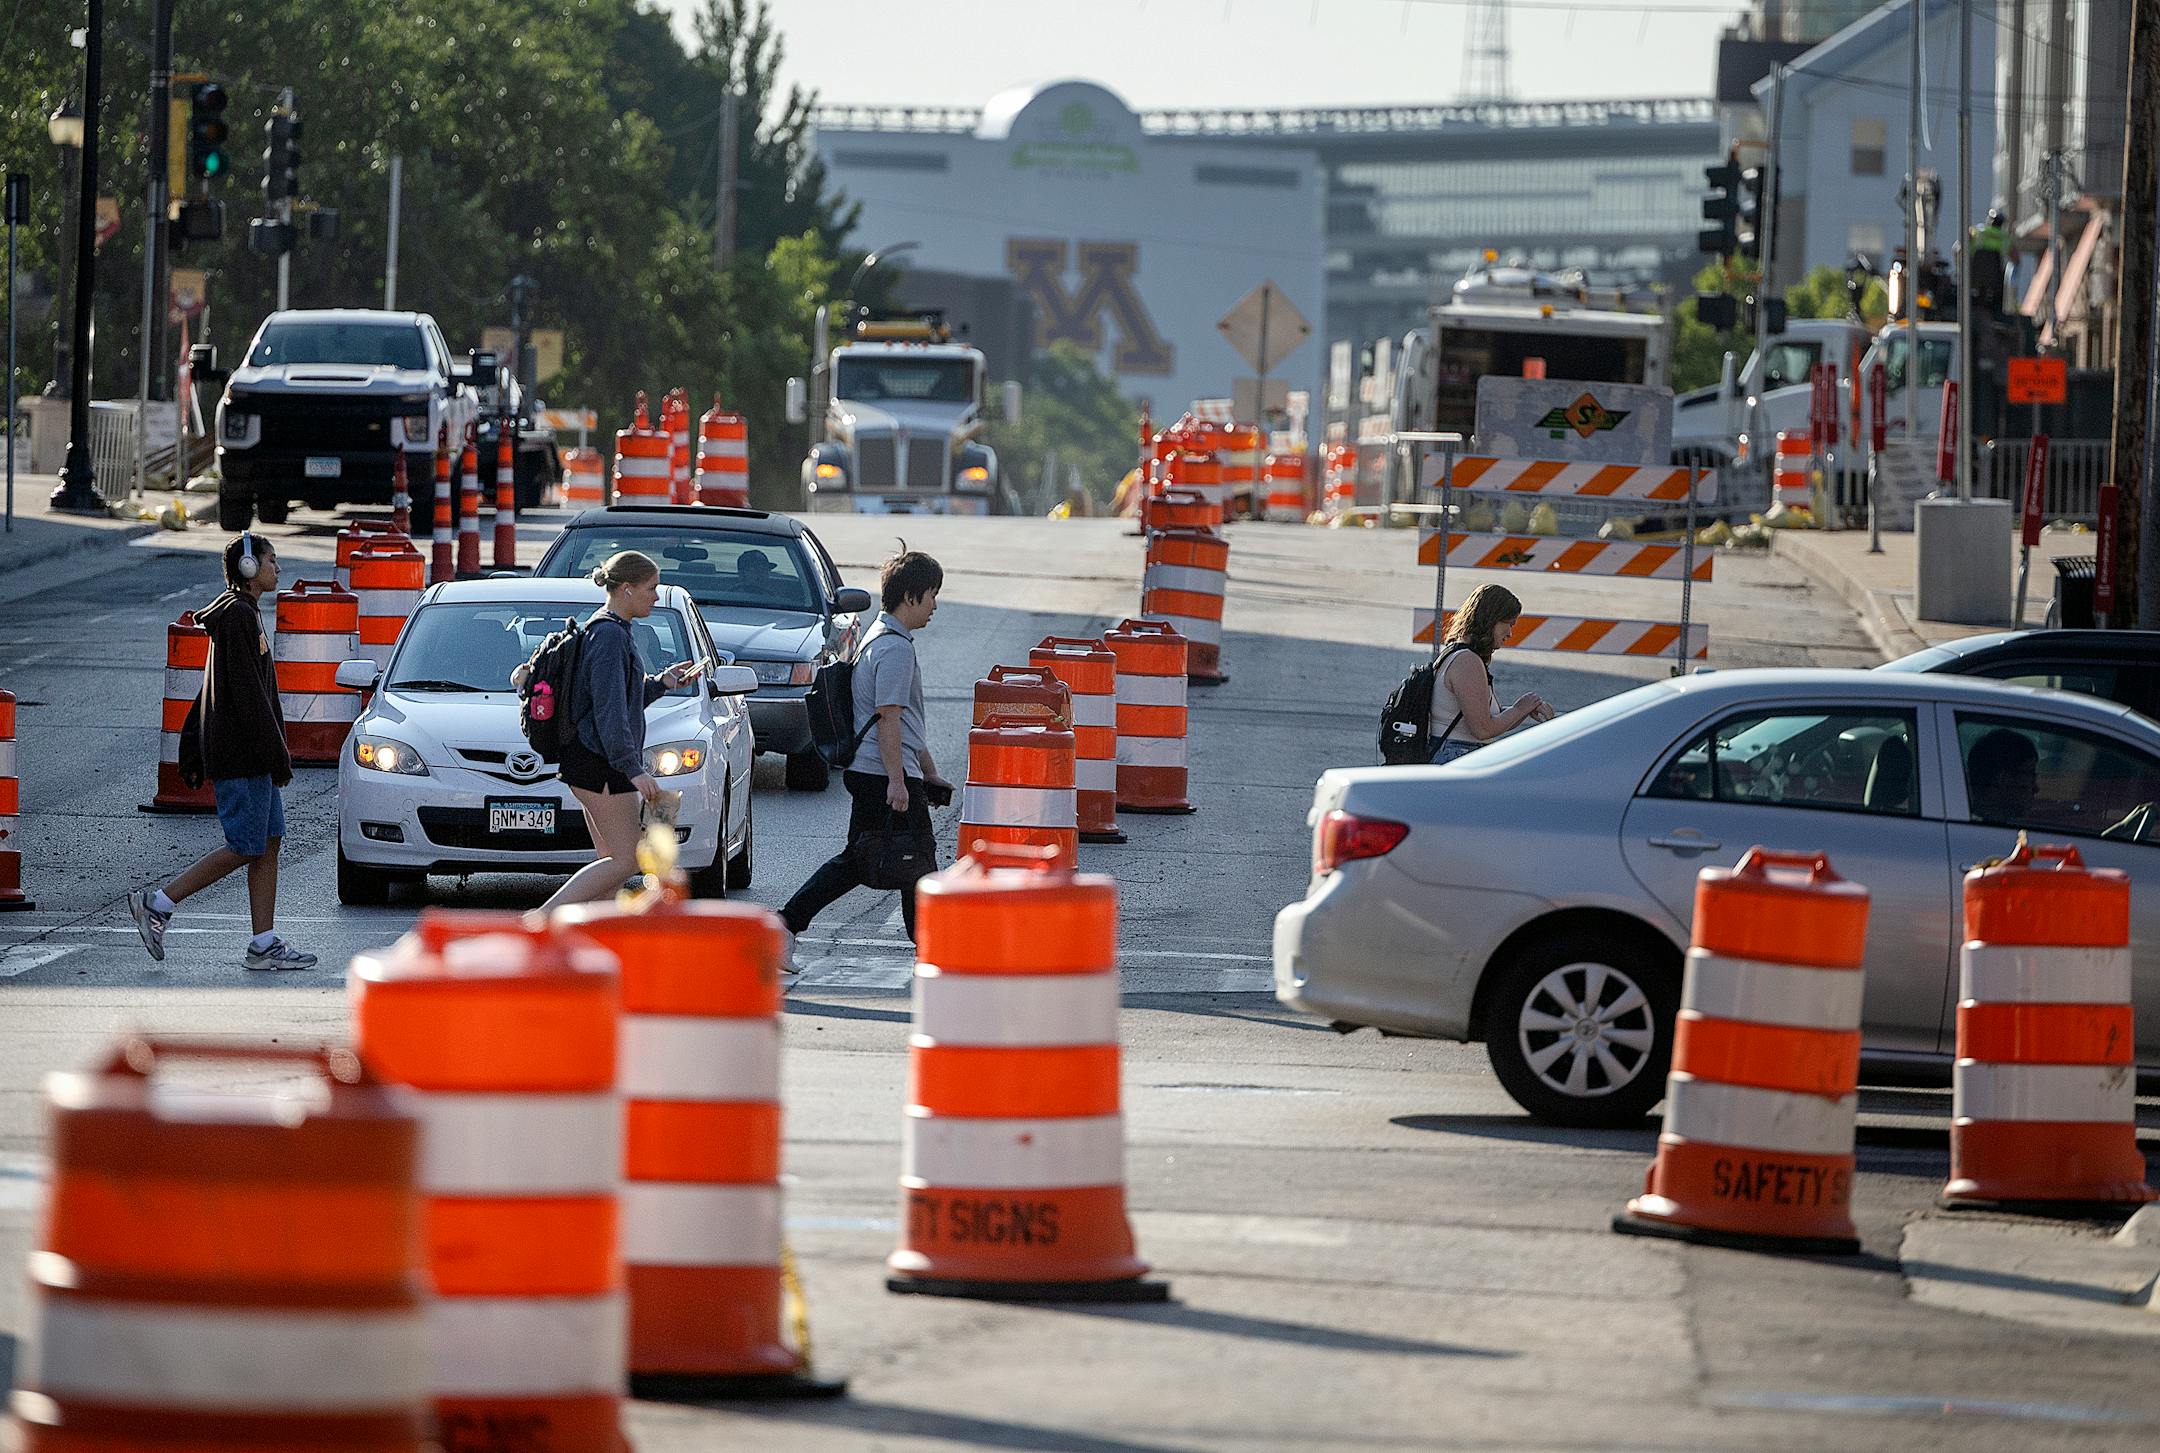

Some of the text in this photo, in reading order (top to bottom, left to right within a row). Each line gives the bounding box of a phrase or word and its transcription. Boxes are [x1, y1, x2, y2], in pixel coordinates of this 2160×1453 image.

[527, 811, 552, 828] 349
[1712, 1158, 1828, 1206] SAFETY
[949, 1198, 1058, 1245] SIGNS
